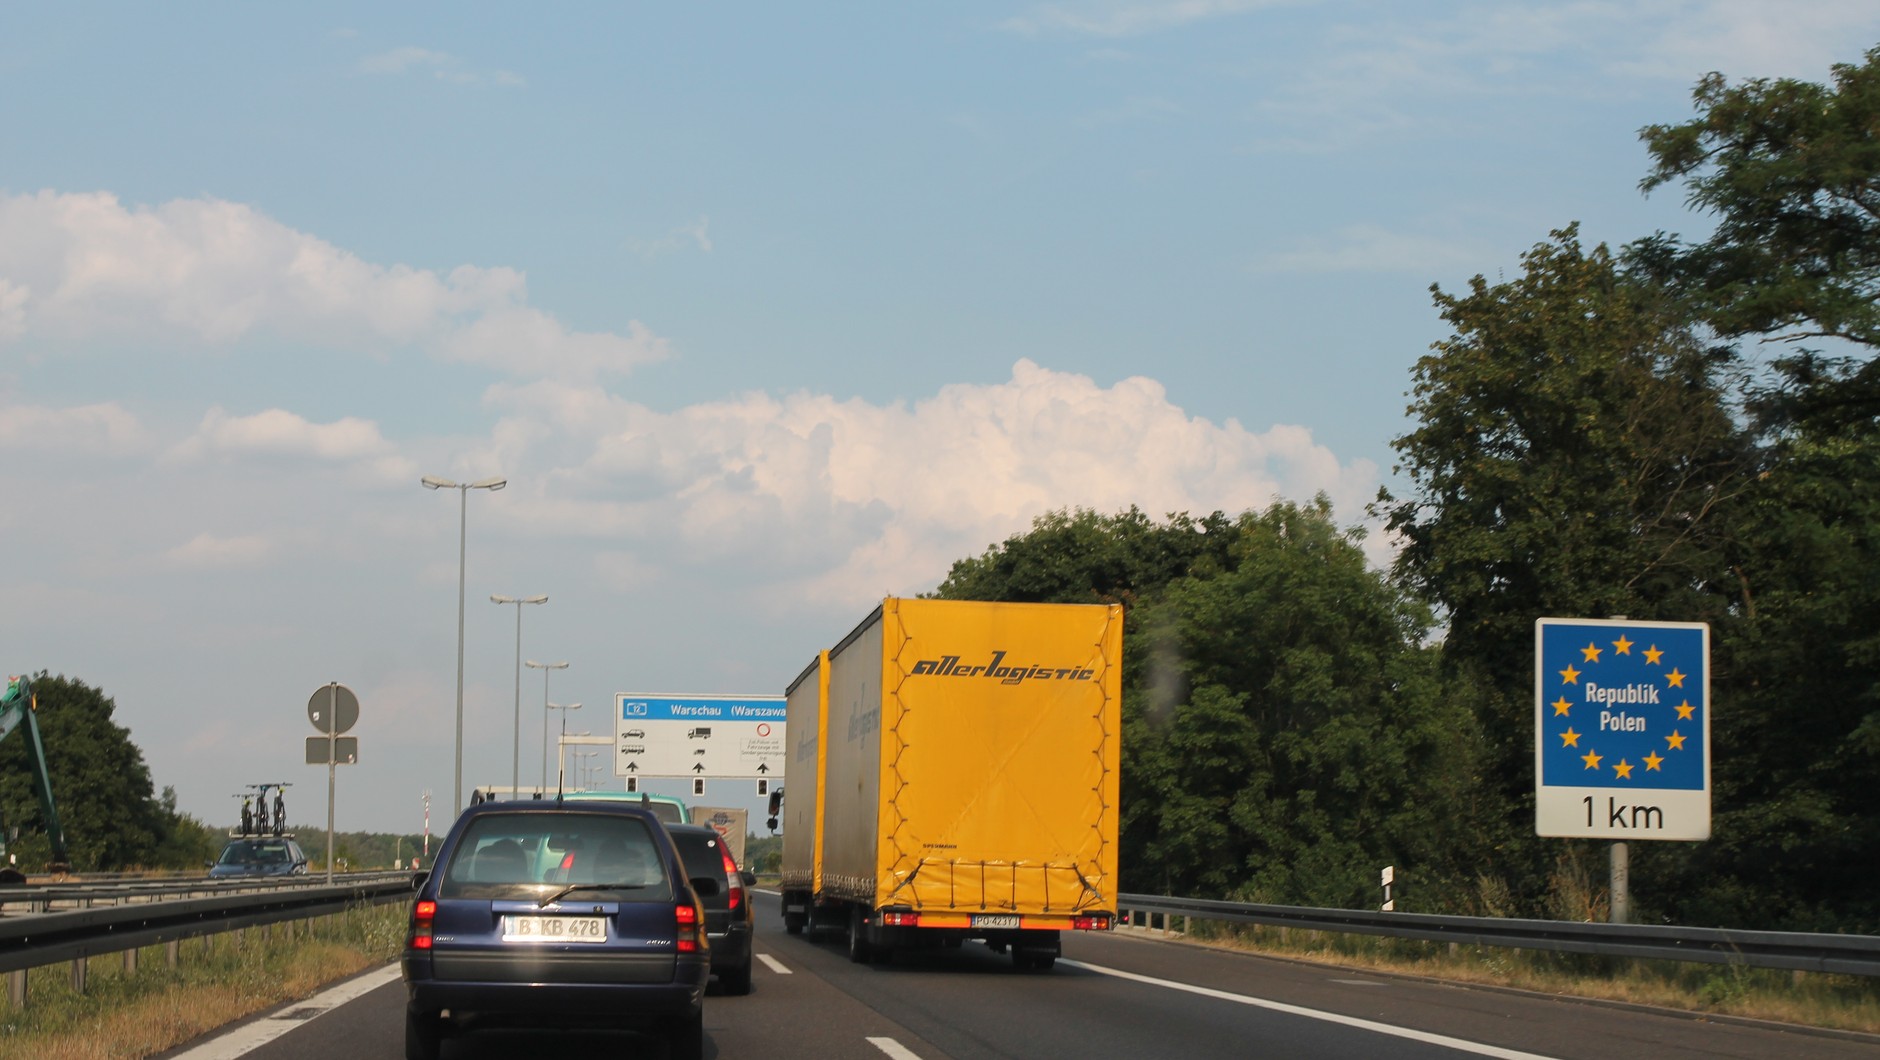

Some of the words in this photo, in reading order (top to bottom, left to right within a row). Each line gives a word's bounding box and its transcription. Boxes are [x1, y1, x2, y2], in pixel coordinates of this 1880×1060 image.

[1585, 682, 1660, 708] Republik
[671, 704, 721, 716] Warschau
[1600, 711, 1646, 732] Polen
[1583, 796, 1593, 828] 1
[1609, 797, 1663, 829] km
[519, 919, 531, 935] B
[540, 919, 564, 936] KB
[568, 919, 600, 936] 478
